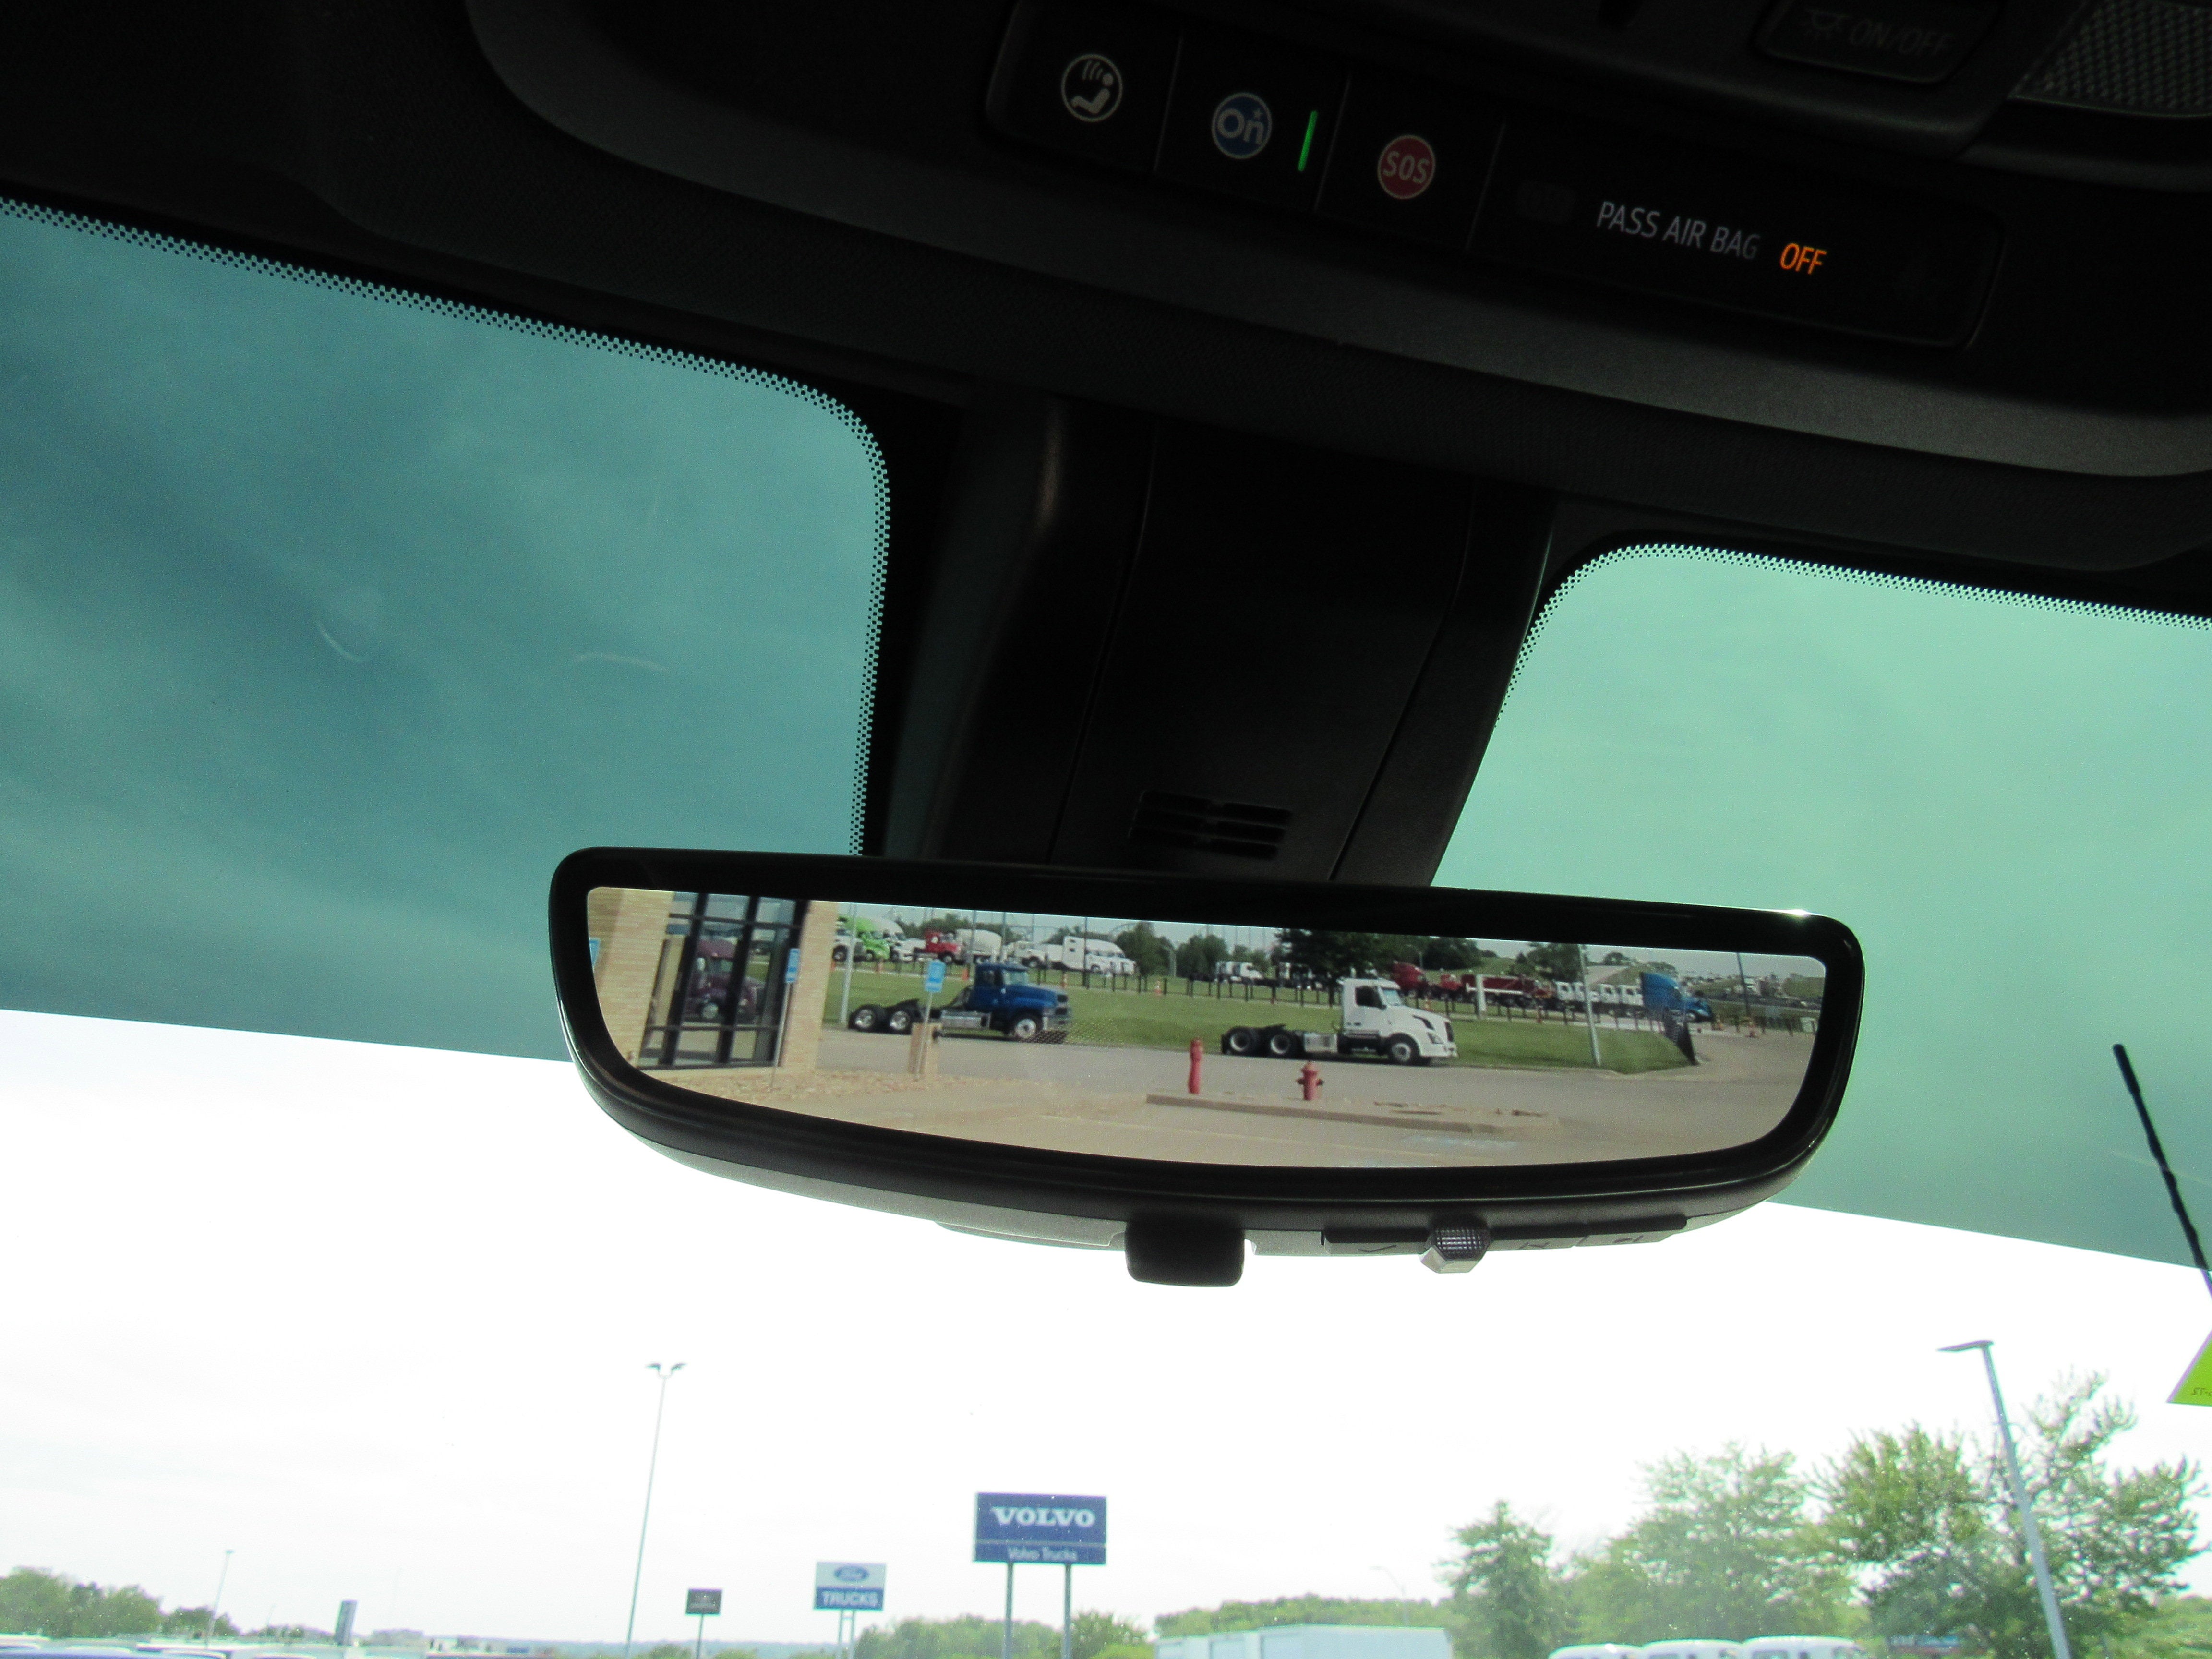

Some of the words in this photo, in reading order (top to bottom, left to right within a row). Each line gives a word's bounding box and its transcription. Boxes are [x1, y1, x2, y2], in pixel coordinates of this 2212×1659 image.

[1848, 18, 1957, 57] ON/OFF
[1382, 150, 1431, 186] SOS
[1596, 201, 1660, 240] PASS
[1662, 216, 1708, 250] AIR
[1710, 227, 1761, 261] BAG
[1778, 241, 1828, 276] OFF
[991, 1506, 1095, 1527] VOLVO
